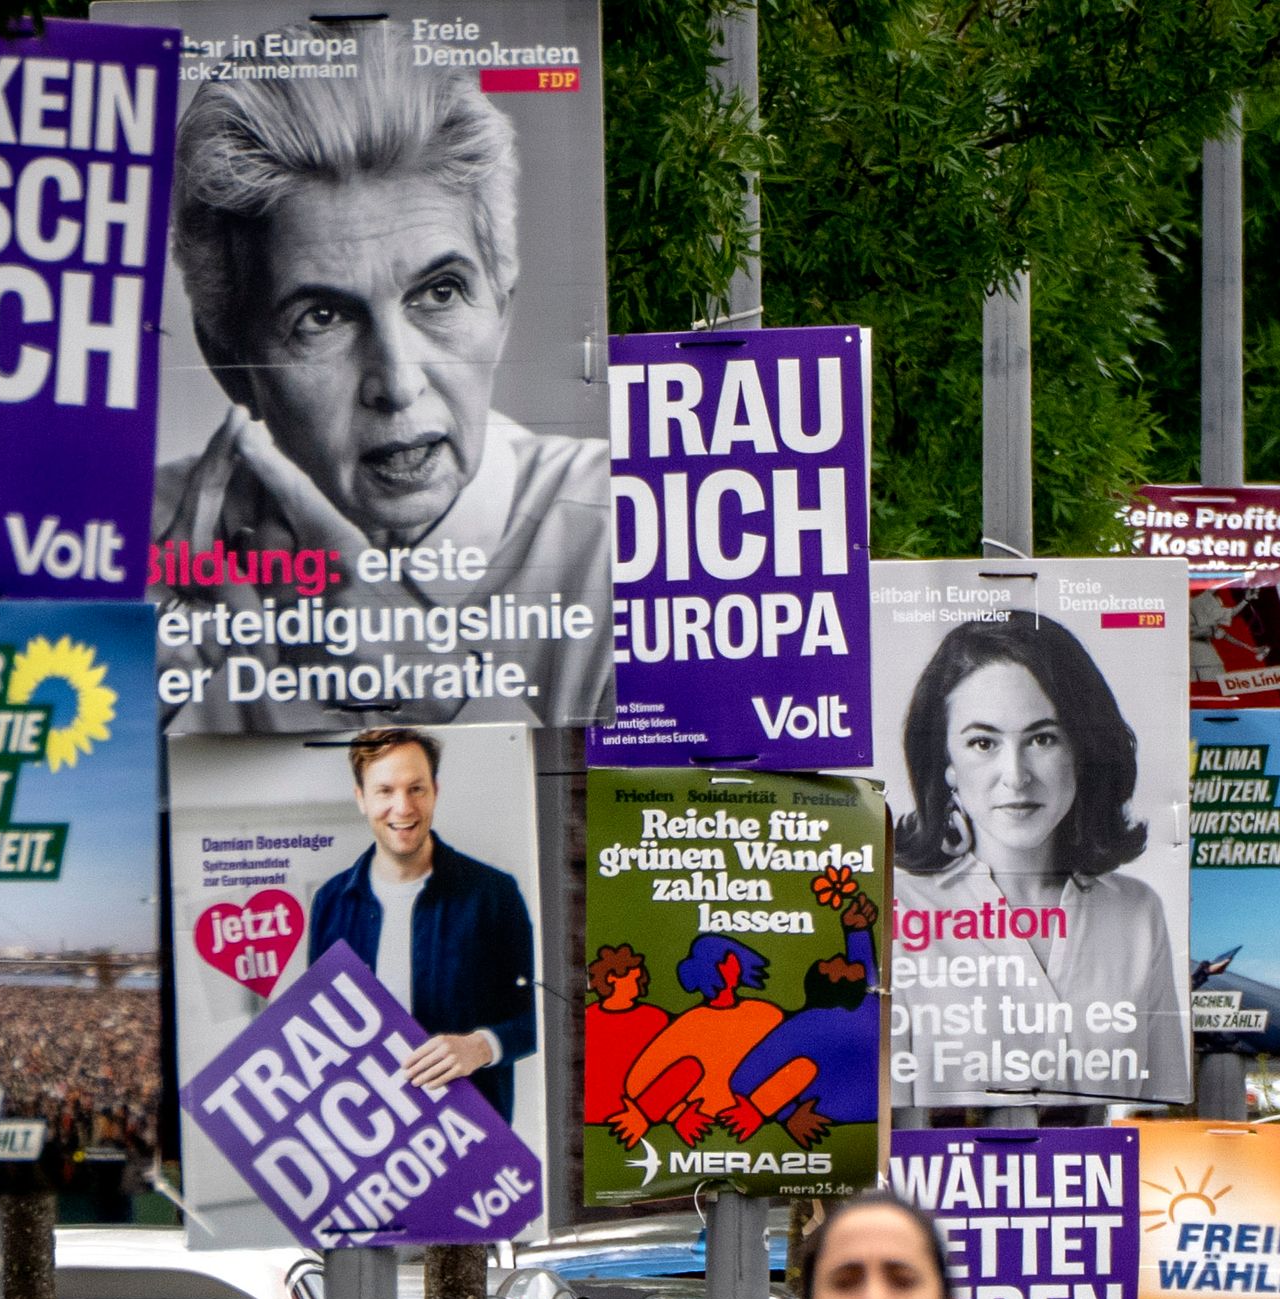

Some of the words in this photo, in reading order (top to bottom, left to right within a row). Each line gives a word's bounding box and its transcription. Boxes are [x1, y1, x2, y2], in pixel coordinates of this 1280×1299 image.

[413, 18, 480, 41] Freie
[233, 35, 258, 58] in
[264, 35, 358, 62] Europa
[413, 44, 580, 67] Demokraten
[538, 72, 577, 88] FDP
[608, 357, 843, 460] TRAU
[611, 467, 849, 584] DICH
[4, 512, 126, 583] Volt
[1150, 532, 1248, 557] Kosten
[356, 539, 487, 583] erste
[871, 587, 922, 604] eitbar
[925, 588, 942, 603] in
[946, 586, 1012, 608] Europa
[1058, 578, 1102, 594] Freie
[892, 608, 936, 623] Isabel
[939, 607, 1012, 623] Schnitzler
[1059, 595, 1166, 612] Demokraten
[157, 592, 595, 656] erteidigungslinie
[613, 592, 849, 663] EUROPA
[1138, 613, 1164, 626] FDP
[157, 668, 214, 703] er
[227, 652, 539, 703] Demokratie.
[1224, 677, 1250, 691] Die
[629, 702, 665, 713] Stimme
[752, 695, 851, 741] Volt
[602, 735, 621, 745] und
[622, 734, 637, 744] ein
[638, 732, 672, 744] starkes
[673, 732, 708, 744] Europa.
[618, 718, 650, 731] mutige
[651, 718, 677, 728] Ideen
[1199, 749, 1261, 771] KLIMA
[615, 788, 674, 803] Frieden
[687, 788, 777, 804] Solidarität
[792, 791, 859, 808] Freiheit
[641, 807, 761, 840] Reiche
[768, 810, 829, 842] für
[202, 837, 253, 852] Damian
[598, 839, 727, 878] grünen
[733, 840, 875, 873] Wandel
[203, 877, 219, 887] zur
[651, 871, 774, 902] zahlen
[210, 903, 292, 951] jetzt
[697, 903, 815, 934] lassen
[893, 897, 1068, 953] igration
[234, 945, 279, 981] du
[892, 953, 1038, 990] euern.
[890, 996, 987, 1037] onst
[999, 995, 1072, 1035] tun
[1085, 1000, 1137, 1034] es
[1192, 995, 1236, 1009] ACHEN,
[1194, 1014, 1221, 1028] WAS
[1222, 1011, 1263, 1029] ZÄHLT.
[202, 972, 383, 1147] TRAU
[891, 1051, 920, 1083] e
[934, 1039, 1150, 1083] Falschen.
[253, 1031, 450, 1223] DICH
[311, 1108, 488, 1249] EUROPA
[670, 1151, 832, 1175] MERA25
[890, 1143, 1124, 1210] WÄHLEN
[455, 1165, 534, 1230] Volt
[778, 1182, 854, 1196] mera25.de
[934, 1215, 1123, 1279] ETTET
